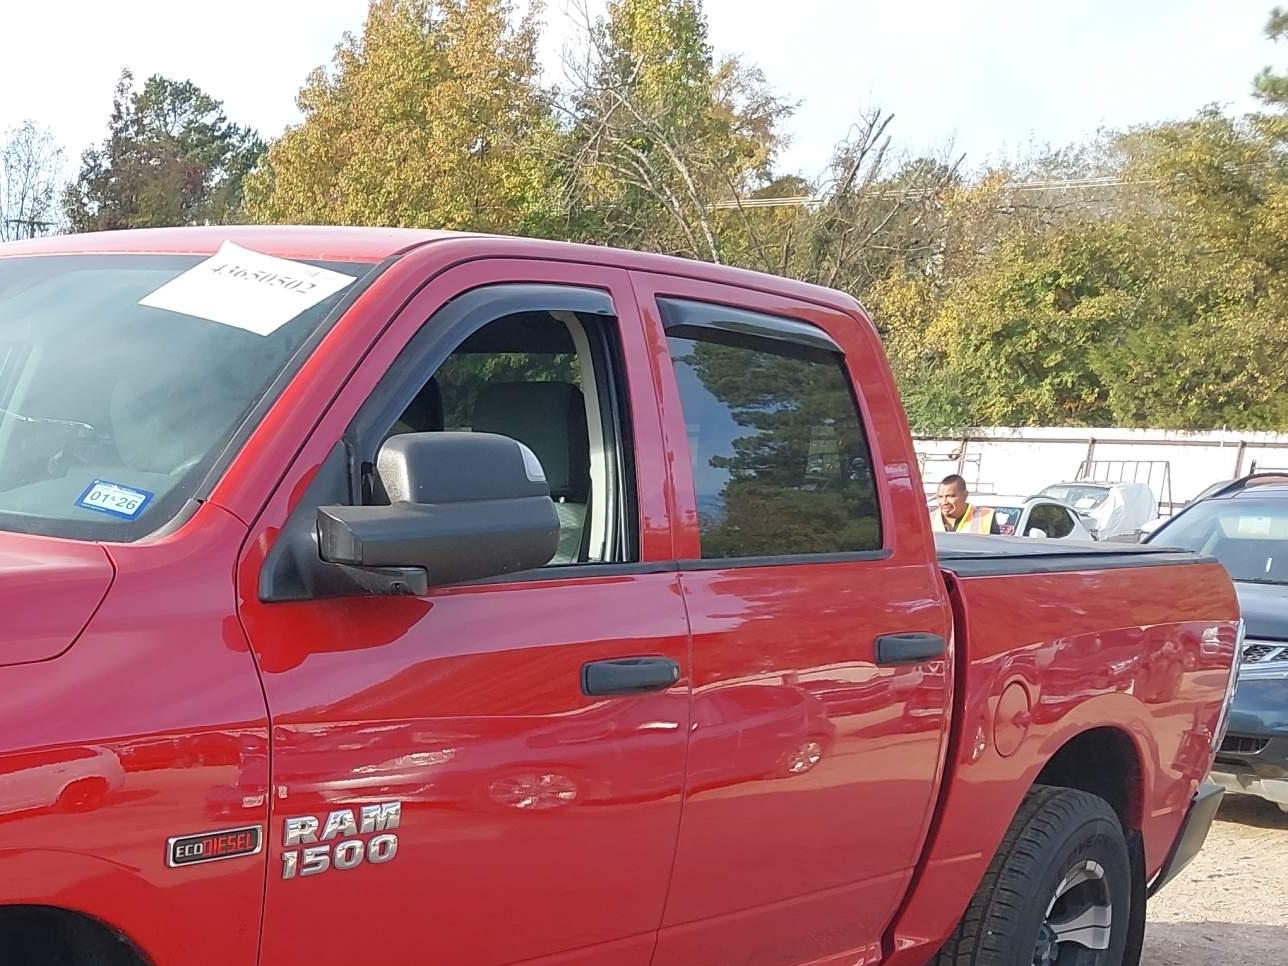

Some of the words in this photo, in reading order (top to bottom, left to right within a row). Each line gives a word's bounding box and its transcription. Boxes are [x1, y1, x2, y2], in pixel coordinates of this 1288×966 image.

[211, 264, 317, 294] 43650502
[90, 491, 111, 503] 01
[115, 497, 138, 510] 26
[283, 801, 402, 847] RAM
[175, 832, 252, 858] ECODIESEL
[282, 834, 399, 880] 1500
